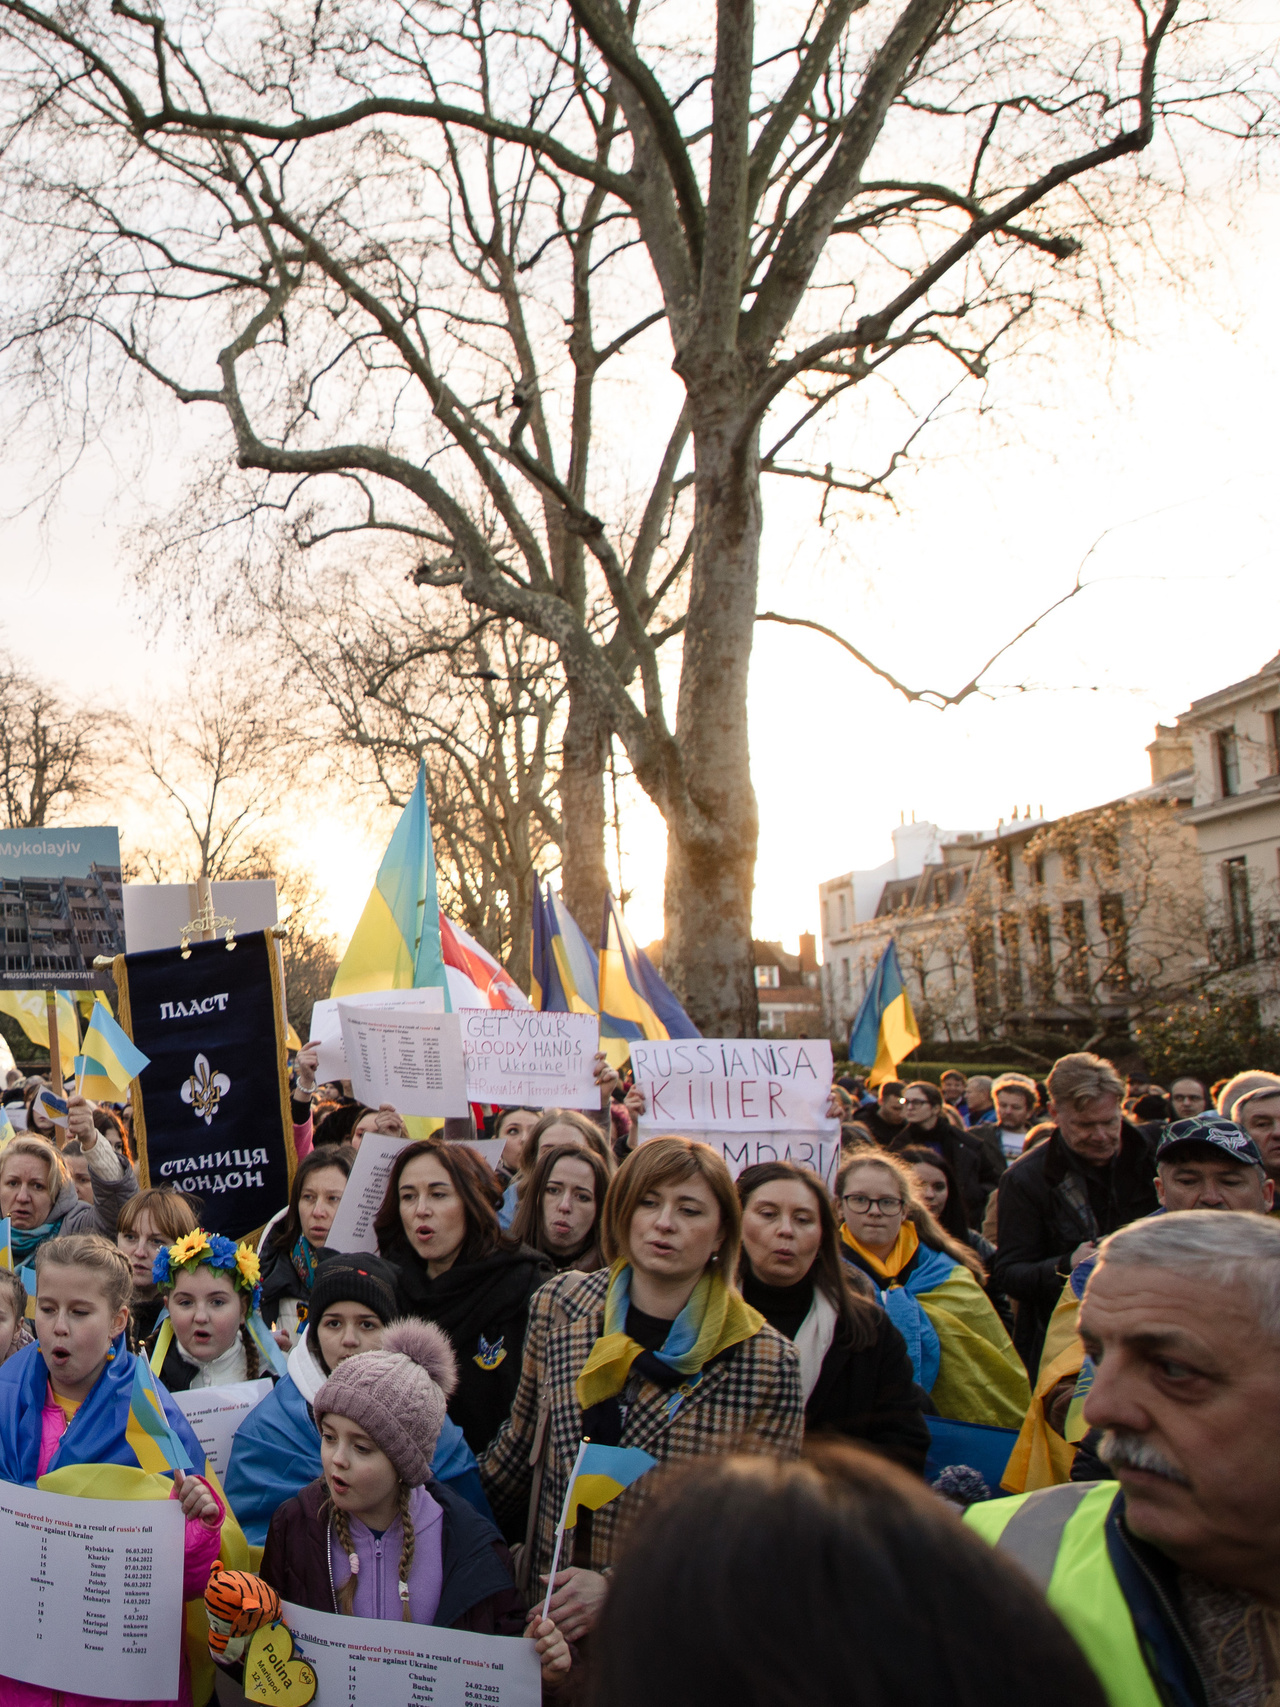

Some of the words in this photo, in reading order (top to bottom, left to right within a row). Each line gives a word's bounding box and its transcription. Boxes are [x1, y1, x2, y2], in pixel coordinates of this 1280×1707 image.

[160, 993, 229, 1020] ПЛАСТ
[467, 1016, 508, 1037] GET
[513, 1018, 571, 1038] YOUR
[464, 1041, 527, 1055] BLOODY
[534, 1040, 581, 1057] HANDS
[467, 1057, 491, 1072] OFF
[160, 1148, 269, 1176] СТАНИЦЯ
[1, 1506, 13, 1514] were
[15, 1510, 43, 1522] murdered
[44, 1527, 66, 1535] against
[68, 1531, 93, 1540] Ukraine
[85, 1587, 110, 1595] Mariupol
[83, 1619, 108, 1627] Mariupol
[82, 1628, 107, 1636] Mariupol
[301, 1633, 328, 1645] children
[348, 1643, 382, 1654] murdered
[384, 1647, 391, 1655] by
[263, 1643, 292, 1689] Polina
[349, 1653, 365, 1662] scale
[367, 1655, 380, 1663] war
[383, 1657, 407, 1666] against
[410, 1660, 437, 1670] Ukraine
[252, 1671, 260, 1682] 12
[257, 1660, 280, 1694] Mariupol
[409, 1673, 436, 1682] Chuhuiv
[413, 1683, 433, 1692] Bucha
[465, 1682, 499, 1693] 24.02.2022
[412, 1693, 434, 1701] Anysiv
[465, 1692, 499, 1702] 05.03.2022
